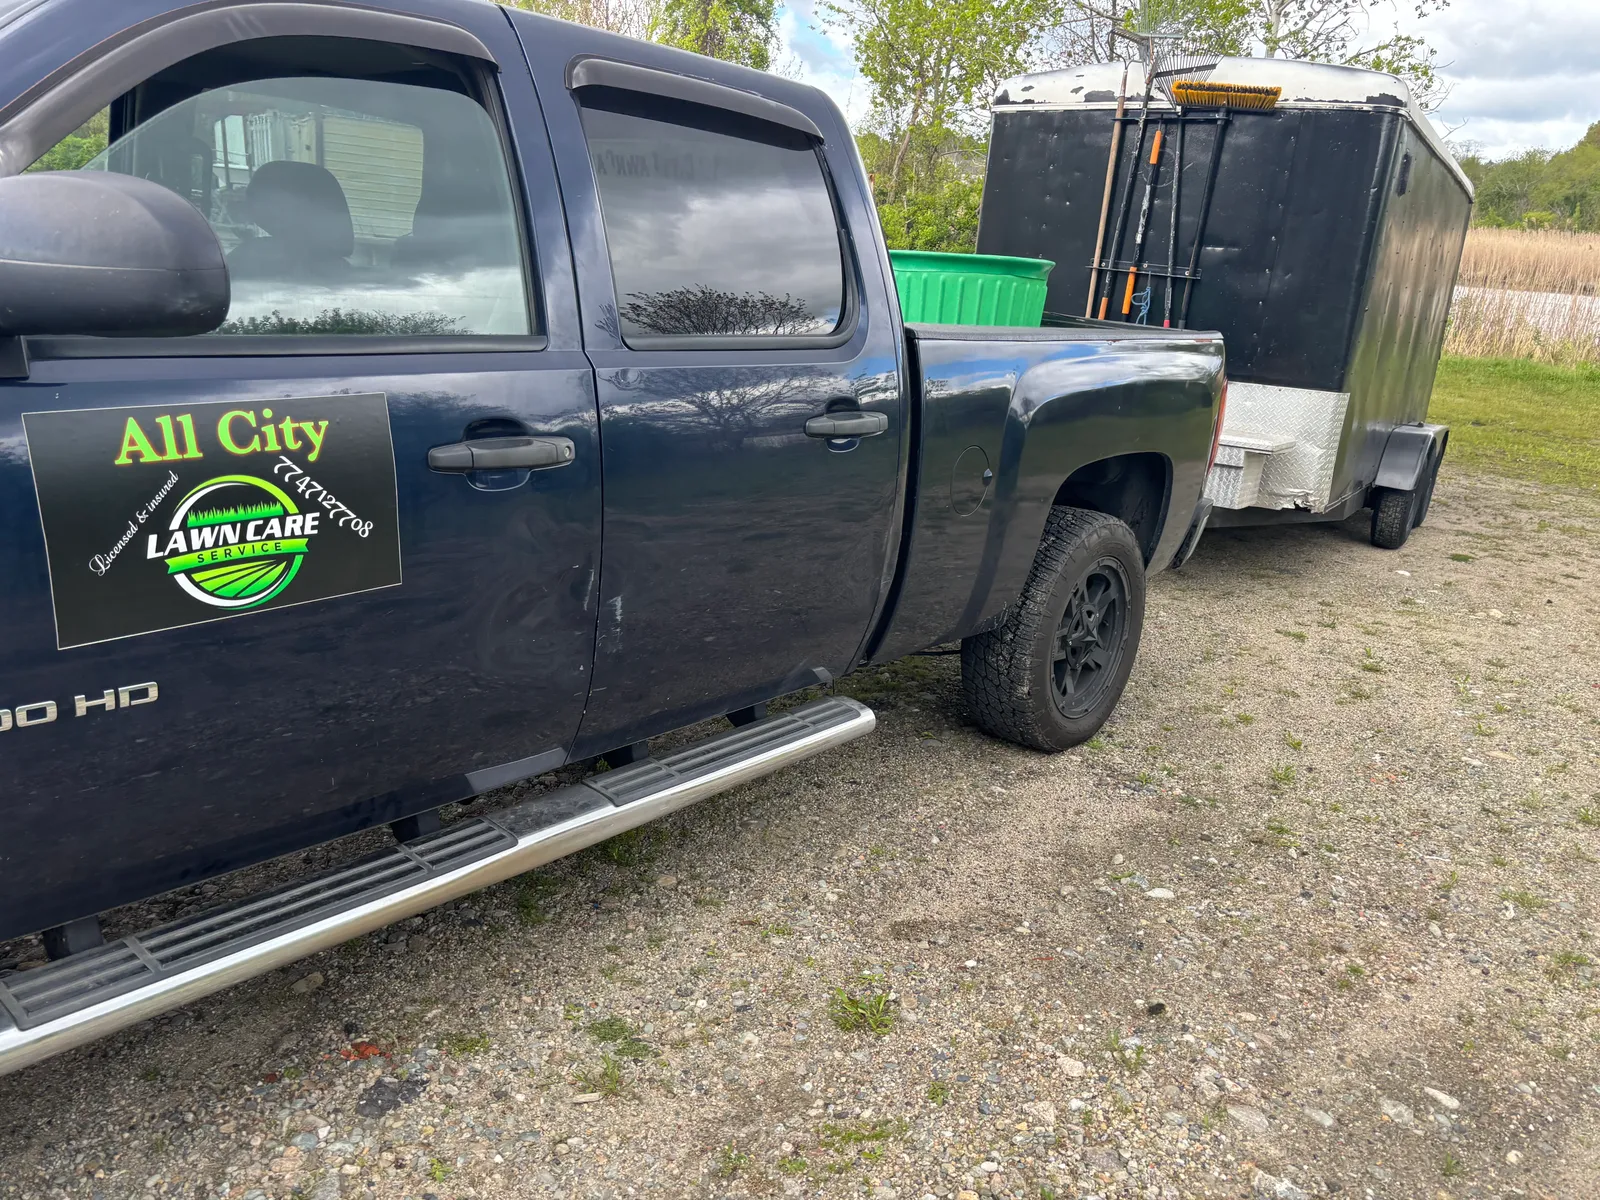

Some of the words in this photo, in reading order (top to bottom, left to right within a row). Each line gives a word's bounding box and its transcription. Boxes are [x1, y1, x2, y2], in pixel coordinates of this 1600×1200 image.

[114, 413, 204, 465] All
[217, 408, 329, 462] City
[273, 455, 374, 538] 7747127708
[89, 520, 139, 576] Licensed
[136, 510, 149, 523] &
[146, 470, 179, 512] insured
[146, 522, 241, 559] LAWN
[246, 511, 320, 541] CARE
[197, 542, 283, 563] SERVICE
[74, 681, 159, 717] HD
